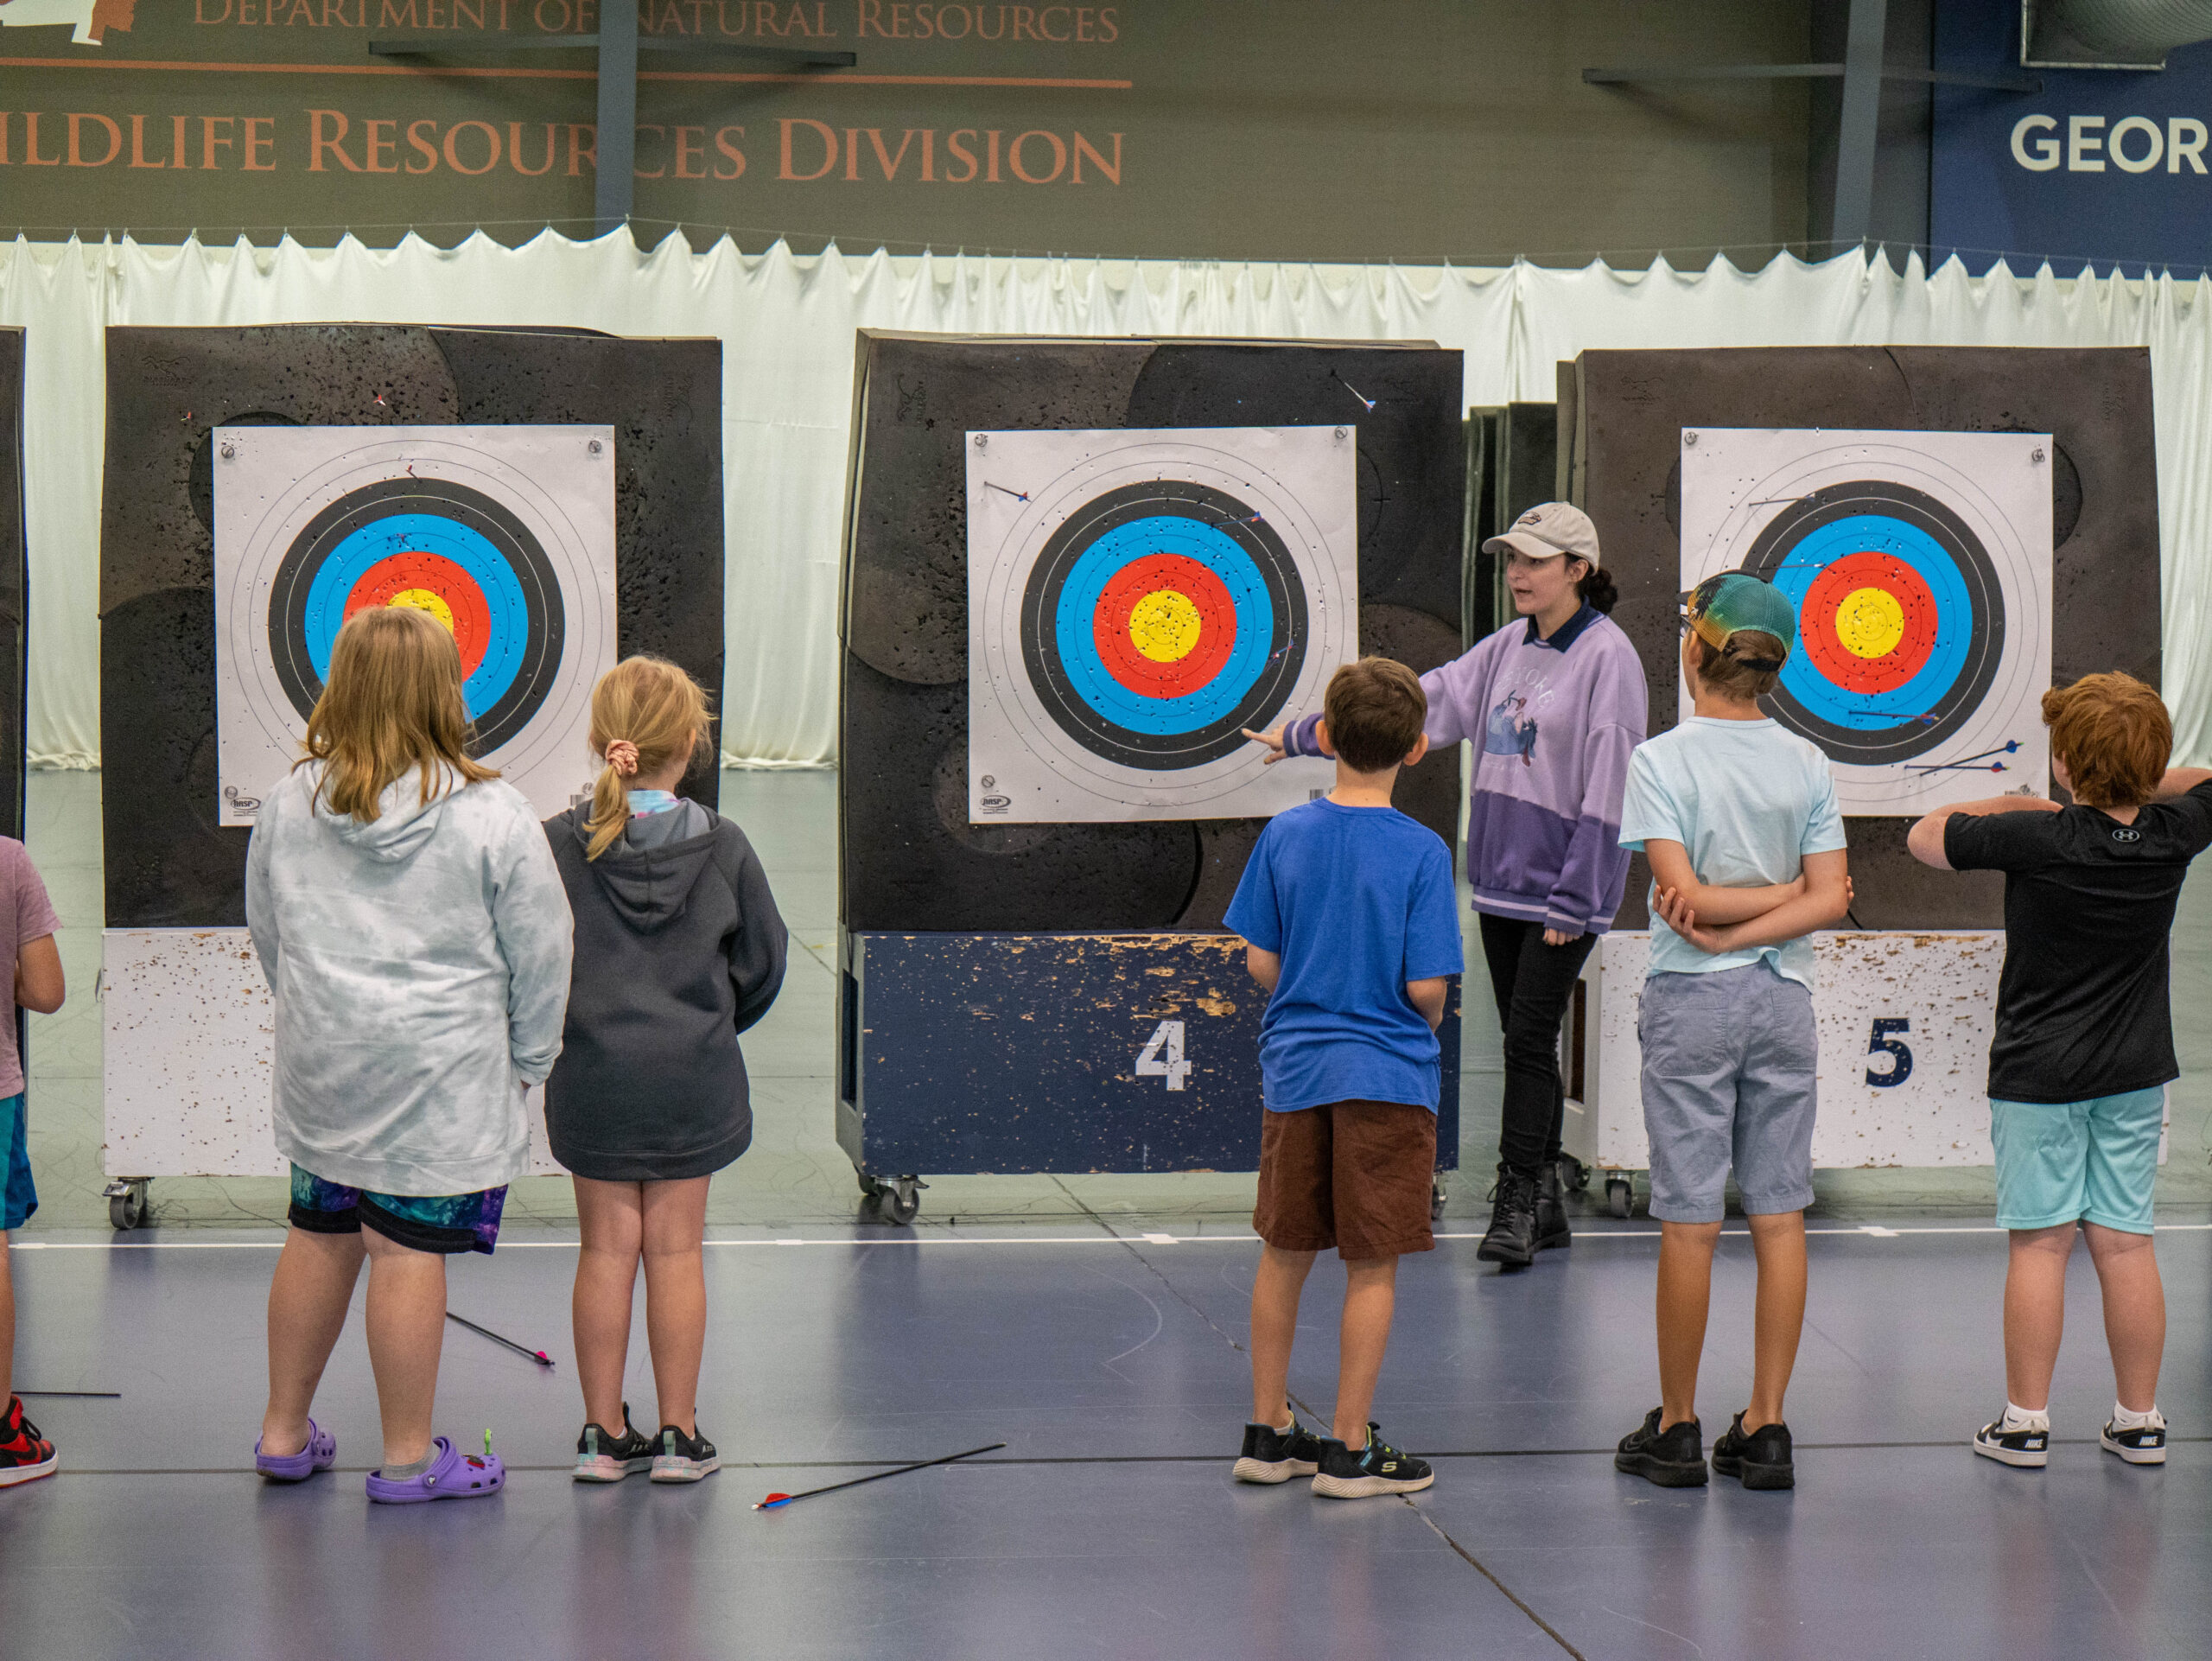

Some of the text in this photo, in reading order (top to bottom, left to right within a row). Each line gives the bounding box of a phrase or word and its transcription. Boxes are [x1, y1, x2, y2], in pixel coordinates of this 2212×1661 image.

[534, 0, 596, 34] OF
[856, 0, 1120, 43] RESOURCES
[775, 118, 1125, 185] DIVISION
[2011, 114, 2209, 174] GEOR
[1135, 1021, 1192, 1091] 4
[1866, 1018, 1914, 1088] 5
[2024, 1439, 2044, 1448] NIKE
[2139, 1435, 2158, 1446] NIKE
